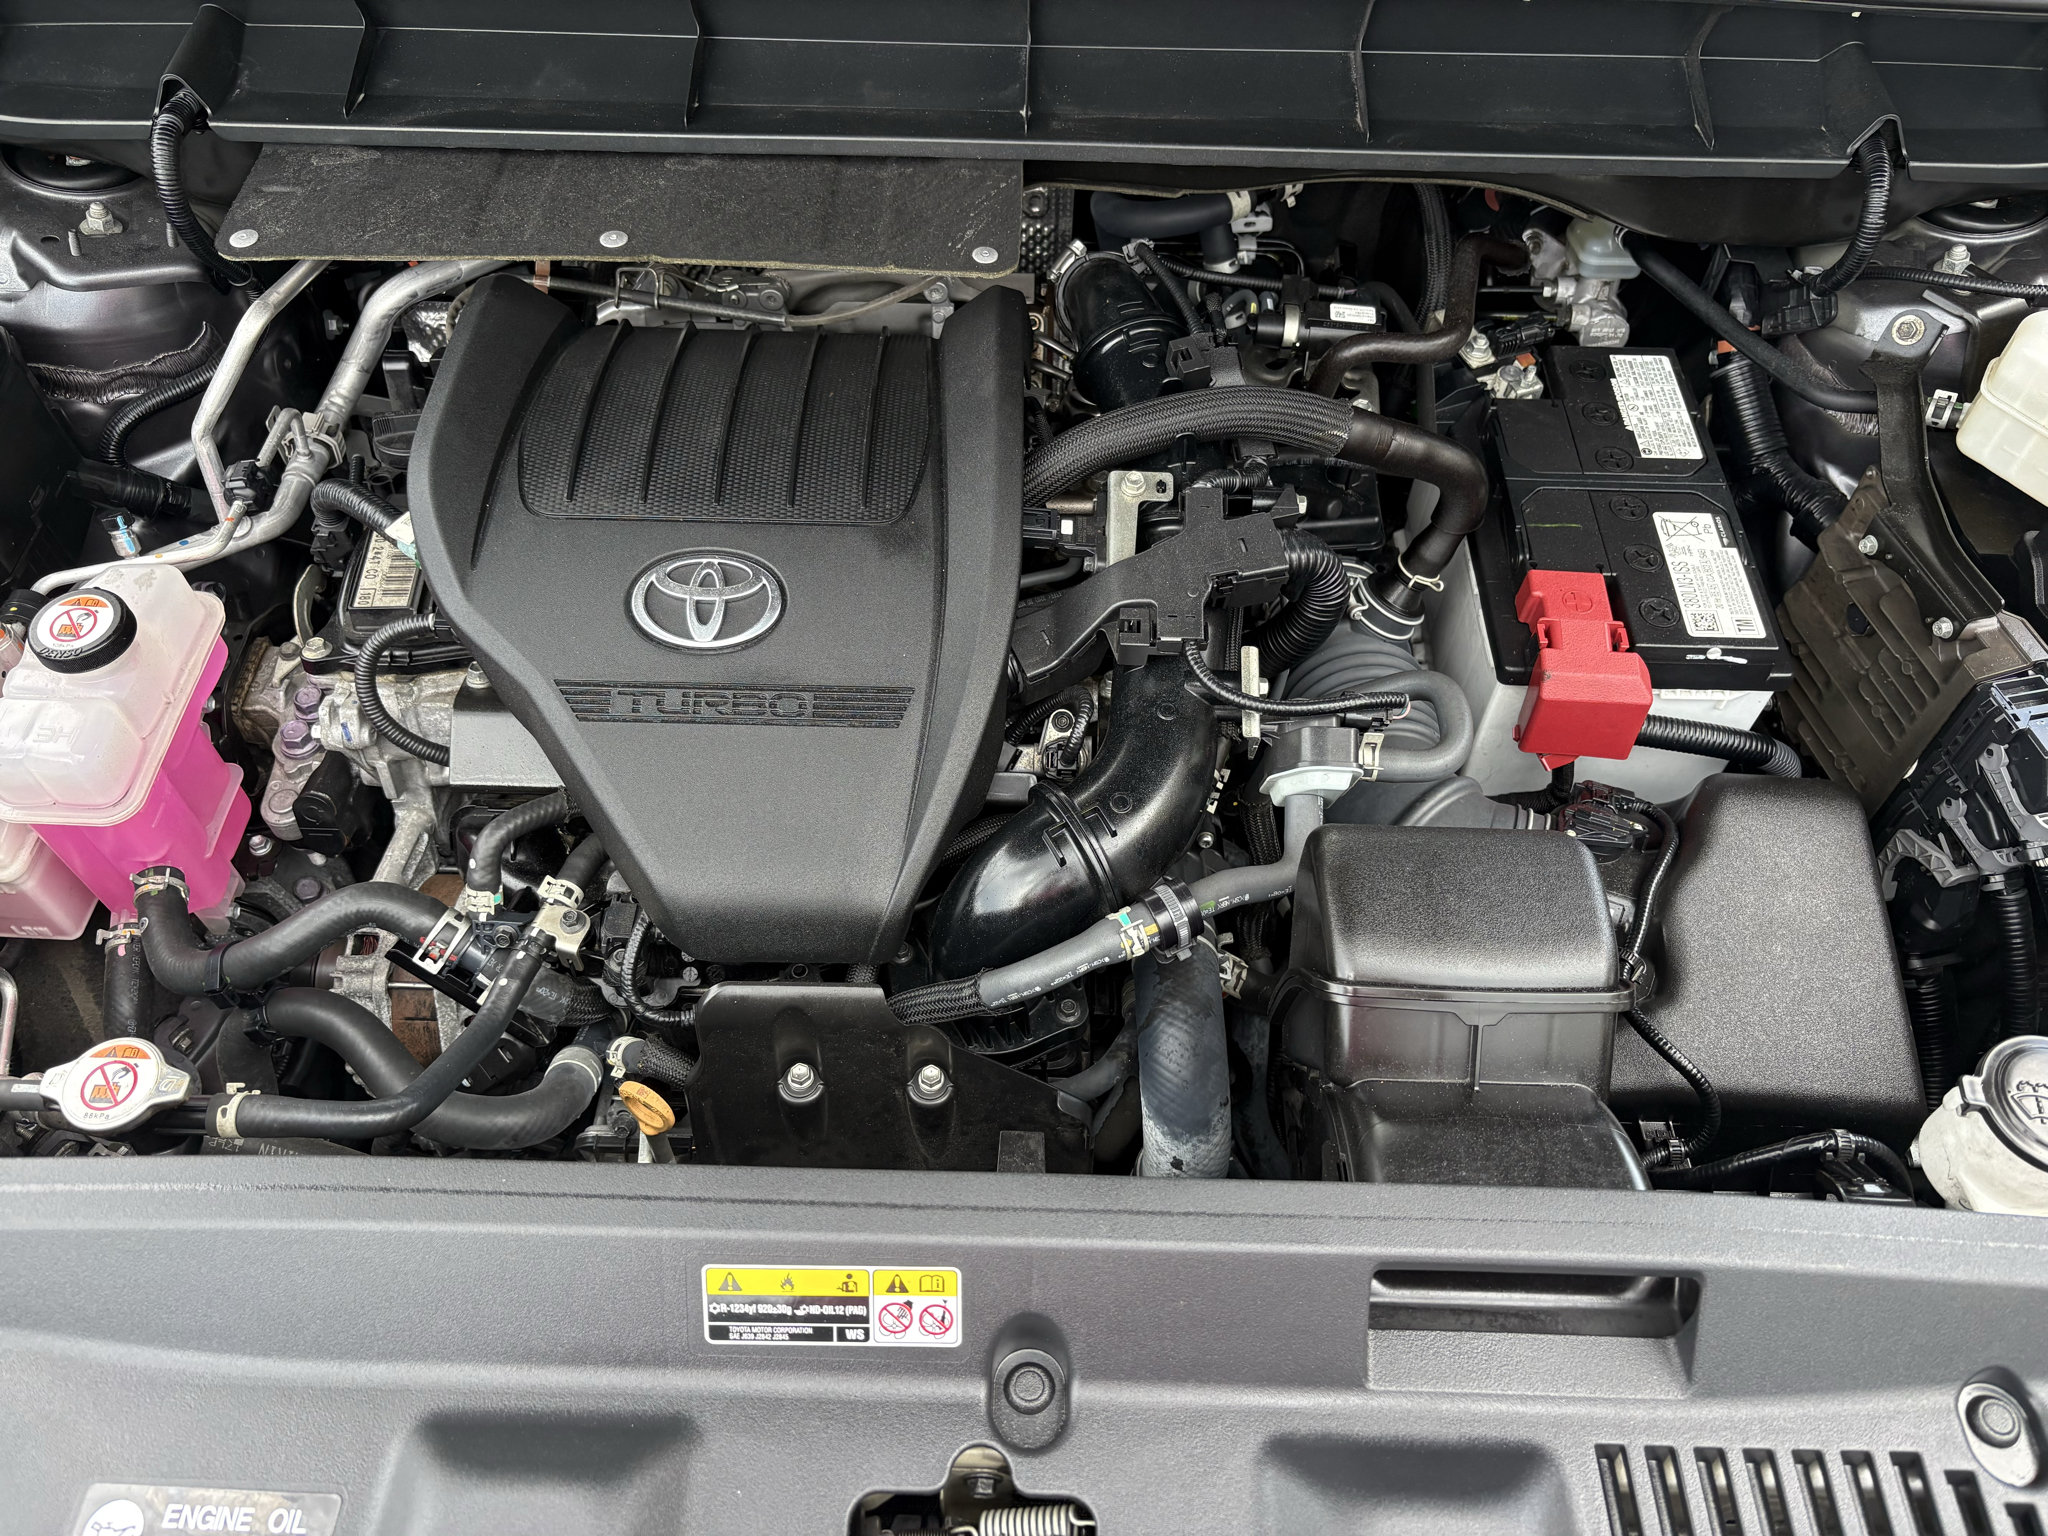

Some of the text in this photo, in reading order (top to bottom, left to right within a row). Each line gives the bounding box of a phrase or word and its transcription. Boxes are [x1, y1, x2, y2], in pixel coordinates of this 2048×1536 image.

[1702, 523, 1714, 535] Pb
[357, 592, 371, 605] 180
[1734, 618, 1756, 633] TM
[39, 647, 82, 658] DENSO
[617, 690, 808, 718] TURBO
[845, 1304, 867, 1317] (PAG)
[751, 1326, 773, 1334] MOTOR
[773, 1327, 813, 1335] CORPORATION
[845, 1328, 866, 1340] WS
[162, 1503, 307, 1535] ENGINE OIL
